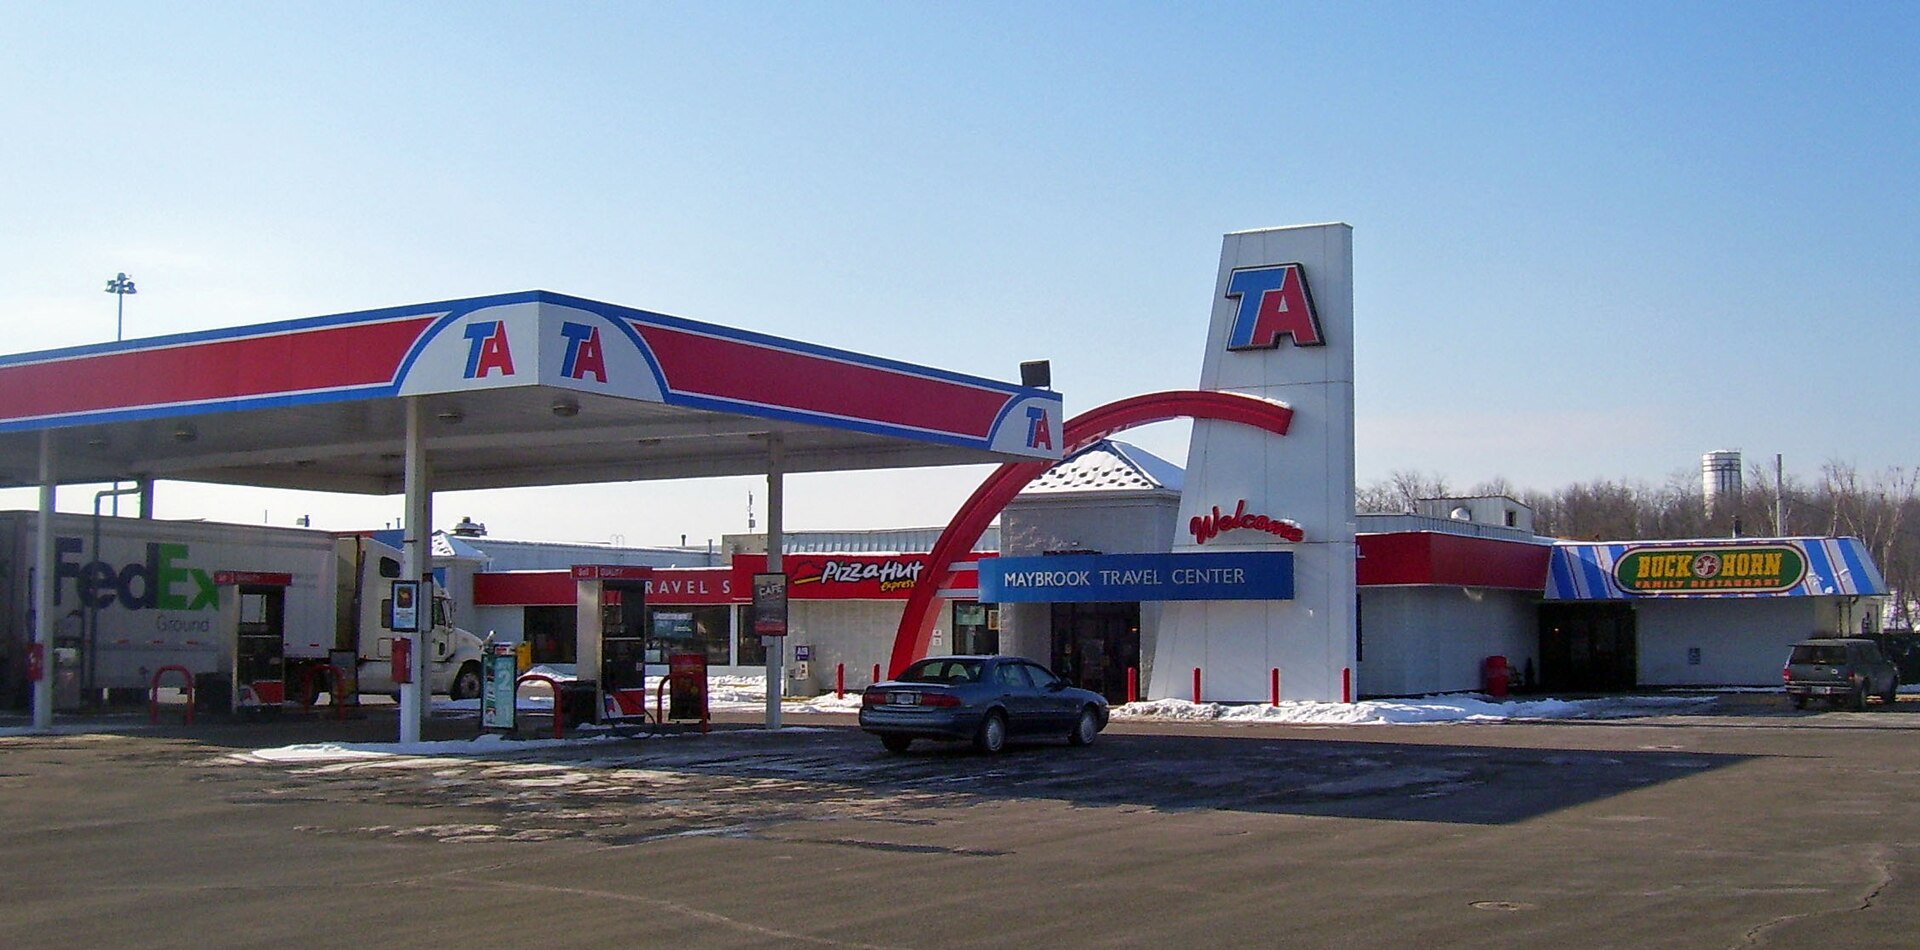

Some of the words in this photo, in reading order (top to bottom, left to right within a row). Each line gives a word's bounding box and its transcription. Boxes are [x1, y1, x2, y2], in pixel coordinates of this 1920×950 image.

[1227, 263, 1324, 350] TA
[463, 320, 515, 379] TA
[560, 321, 608, 383] TA
[1026, 406, 1052, 451] TA
[1189, 499, 1305, 545] Welcome
[54, 536, 219, 611] FedEx
[1004, 571, 1090, 587] MAYBROOK
[1100, 570, 1163, 586] TRAVEL
[1171, 568, 1246, 584] CENTER
[1637, 554, 1693, 578] BUCK
[1720, 552, 1783, 577] HORN
[644, 580, 709, 594] RAVEL
[880, 580, 915, 592] express
[1635, 580, 1685, 589] FAMILY
[1690, 578, 1781, 588] RESTAURANT
[156, 614, 210, 633] Ground
